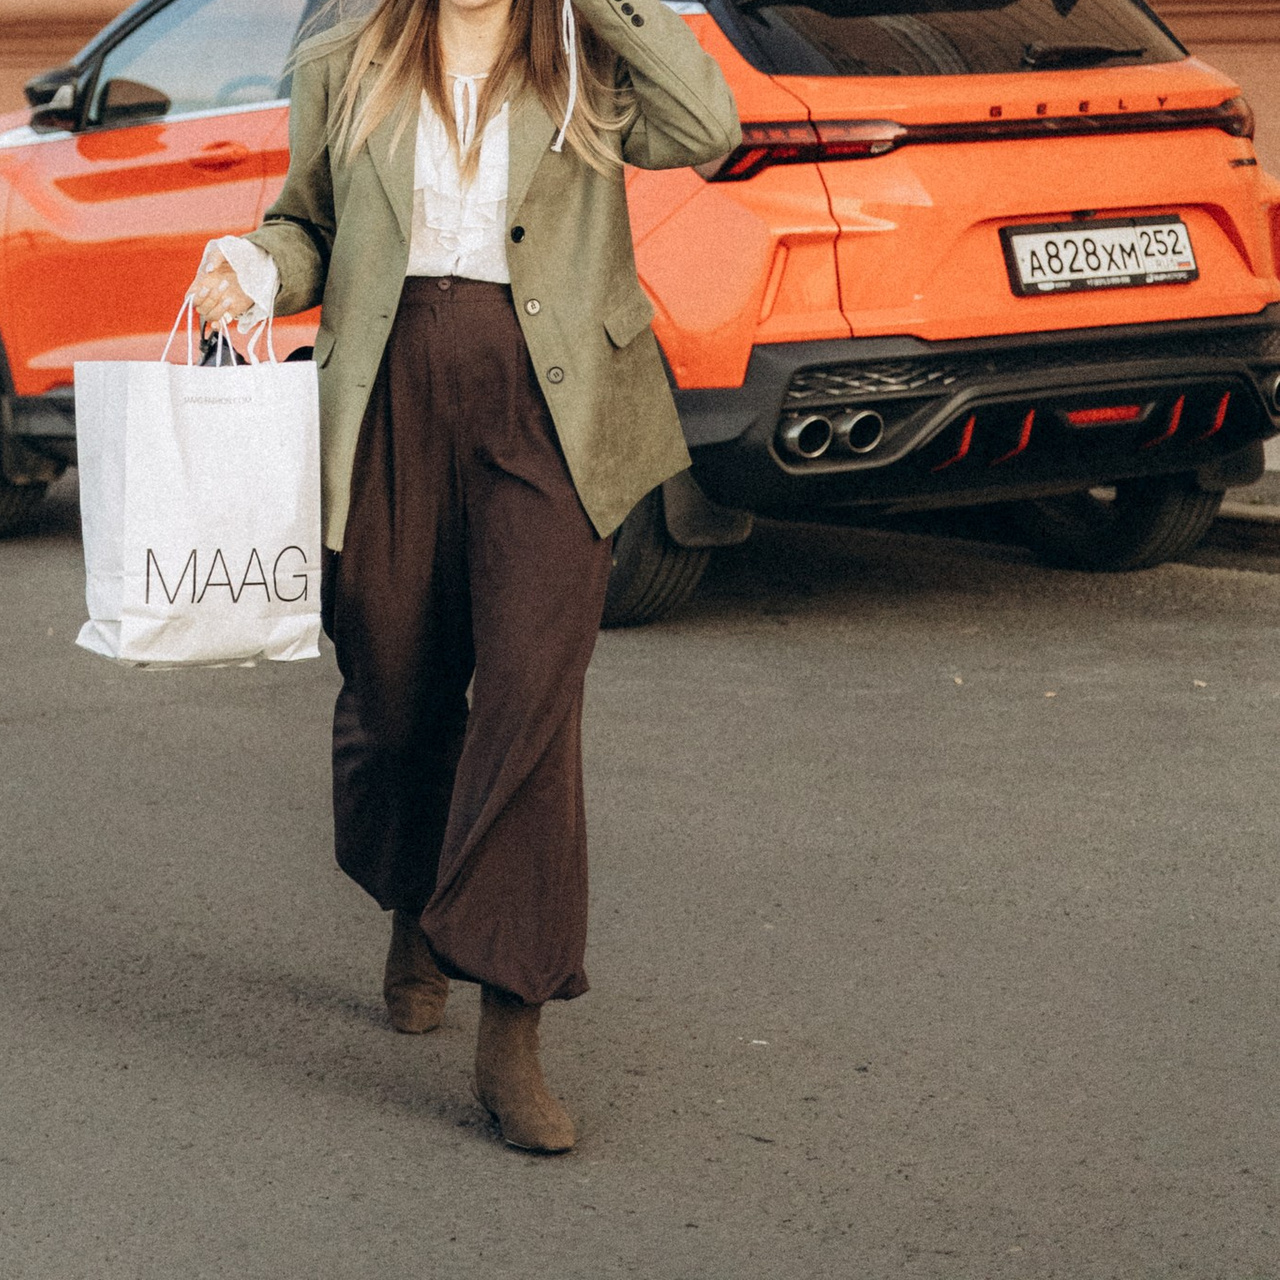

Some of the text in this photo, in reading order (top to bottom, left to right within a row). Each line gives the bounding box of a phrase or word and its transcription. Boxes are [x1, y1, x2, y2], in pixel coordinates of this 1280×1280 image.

[990, 97, 1167, 117] GEELY
[1140, 229, 1183, 257] 252
[145, 545, 308, 604] MAAG
